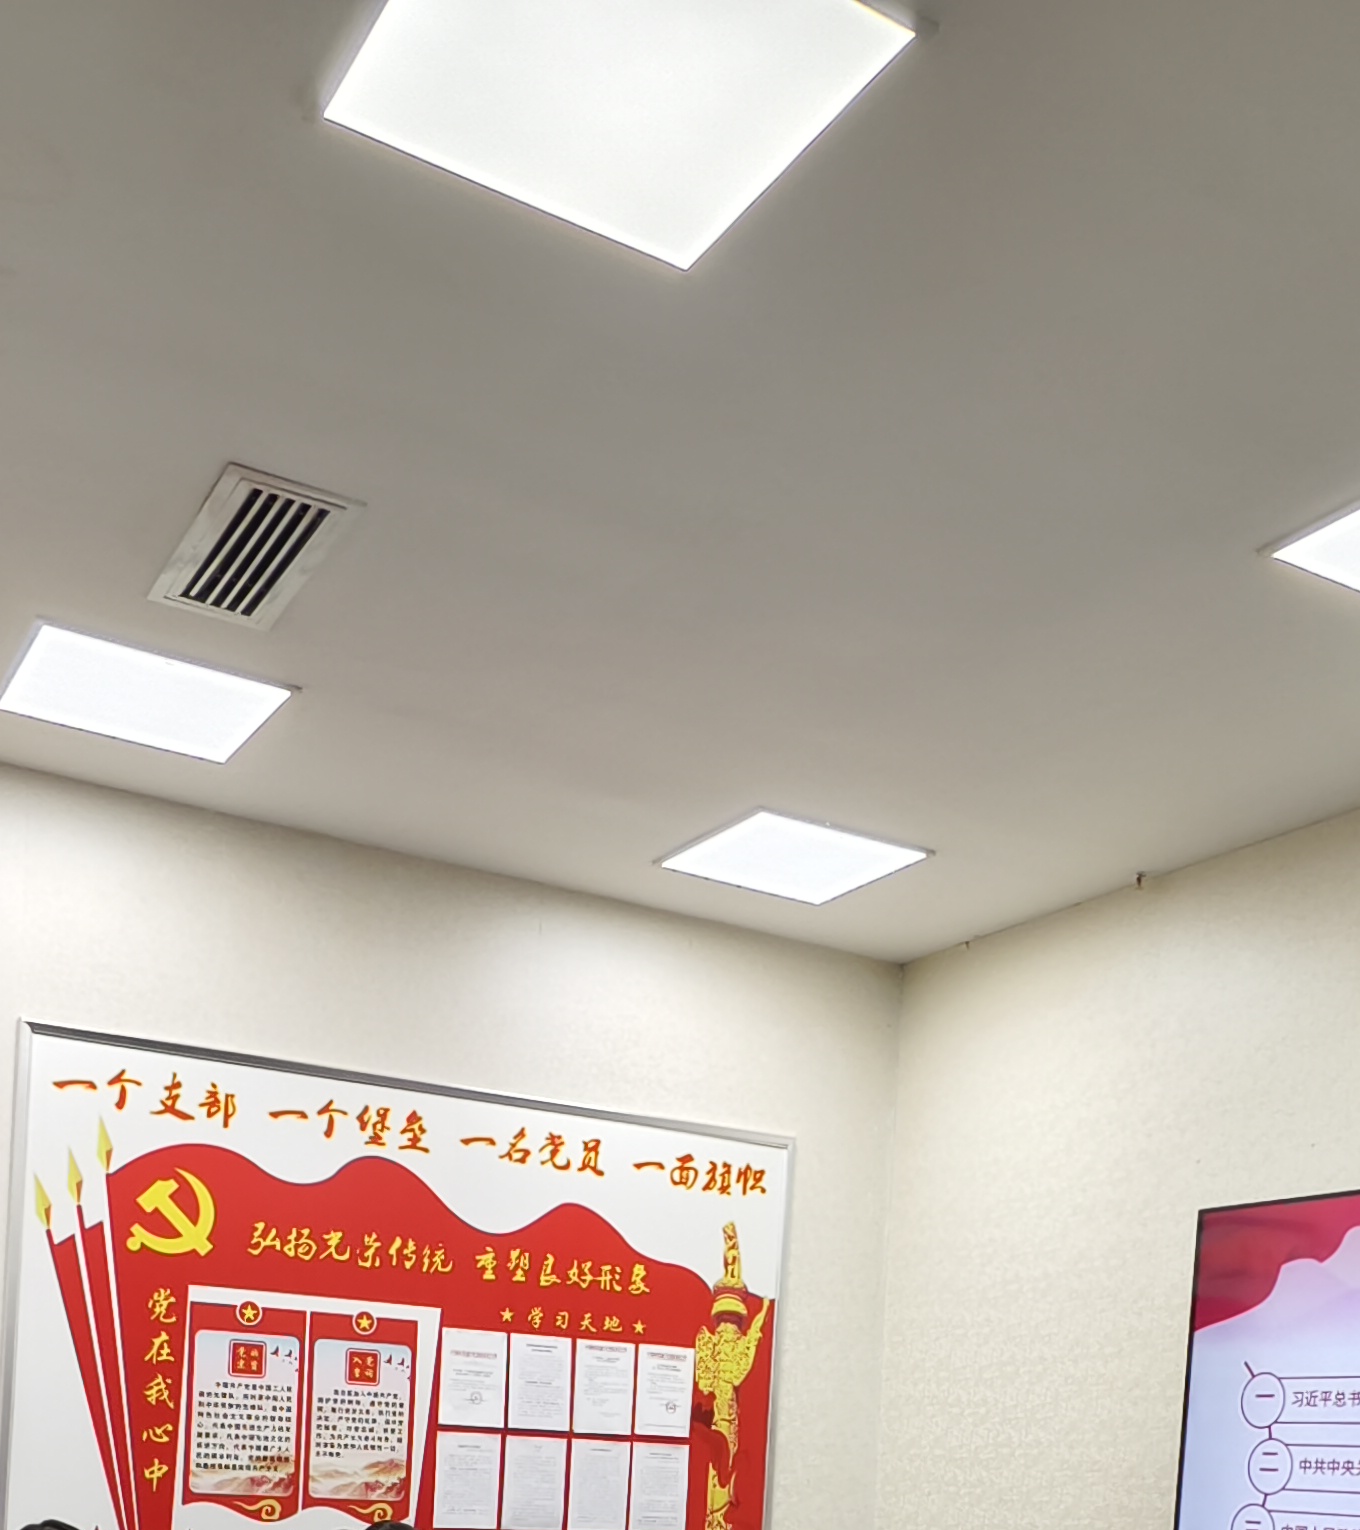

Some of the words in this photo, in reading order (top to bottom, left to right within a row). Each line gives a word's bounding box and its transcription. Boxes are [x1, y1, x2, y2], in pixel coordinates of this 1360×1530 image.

[52, 1069, 237, 1128] 一个支部
[268, 1099, 430, 1153] 一个堡垒
[460, 1127, 605, 1177] 一名党员
[633, 1154, 767, 1195] 一面旗帜
[247, 1222, 453, 1274] 弘扬光荣传统
[475, 1247, 651, 1295] 重塑良好形象
[527, 1307, 623, 1333] 学习天地
[142, 1288, 178, 1493] 党在我心中
[1259, 1451, 1279, 1472] 二
